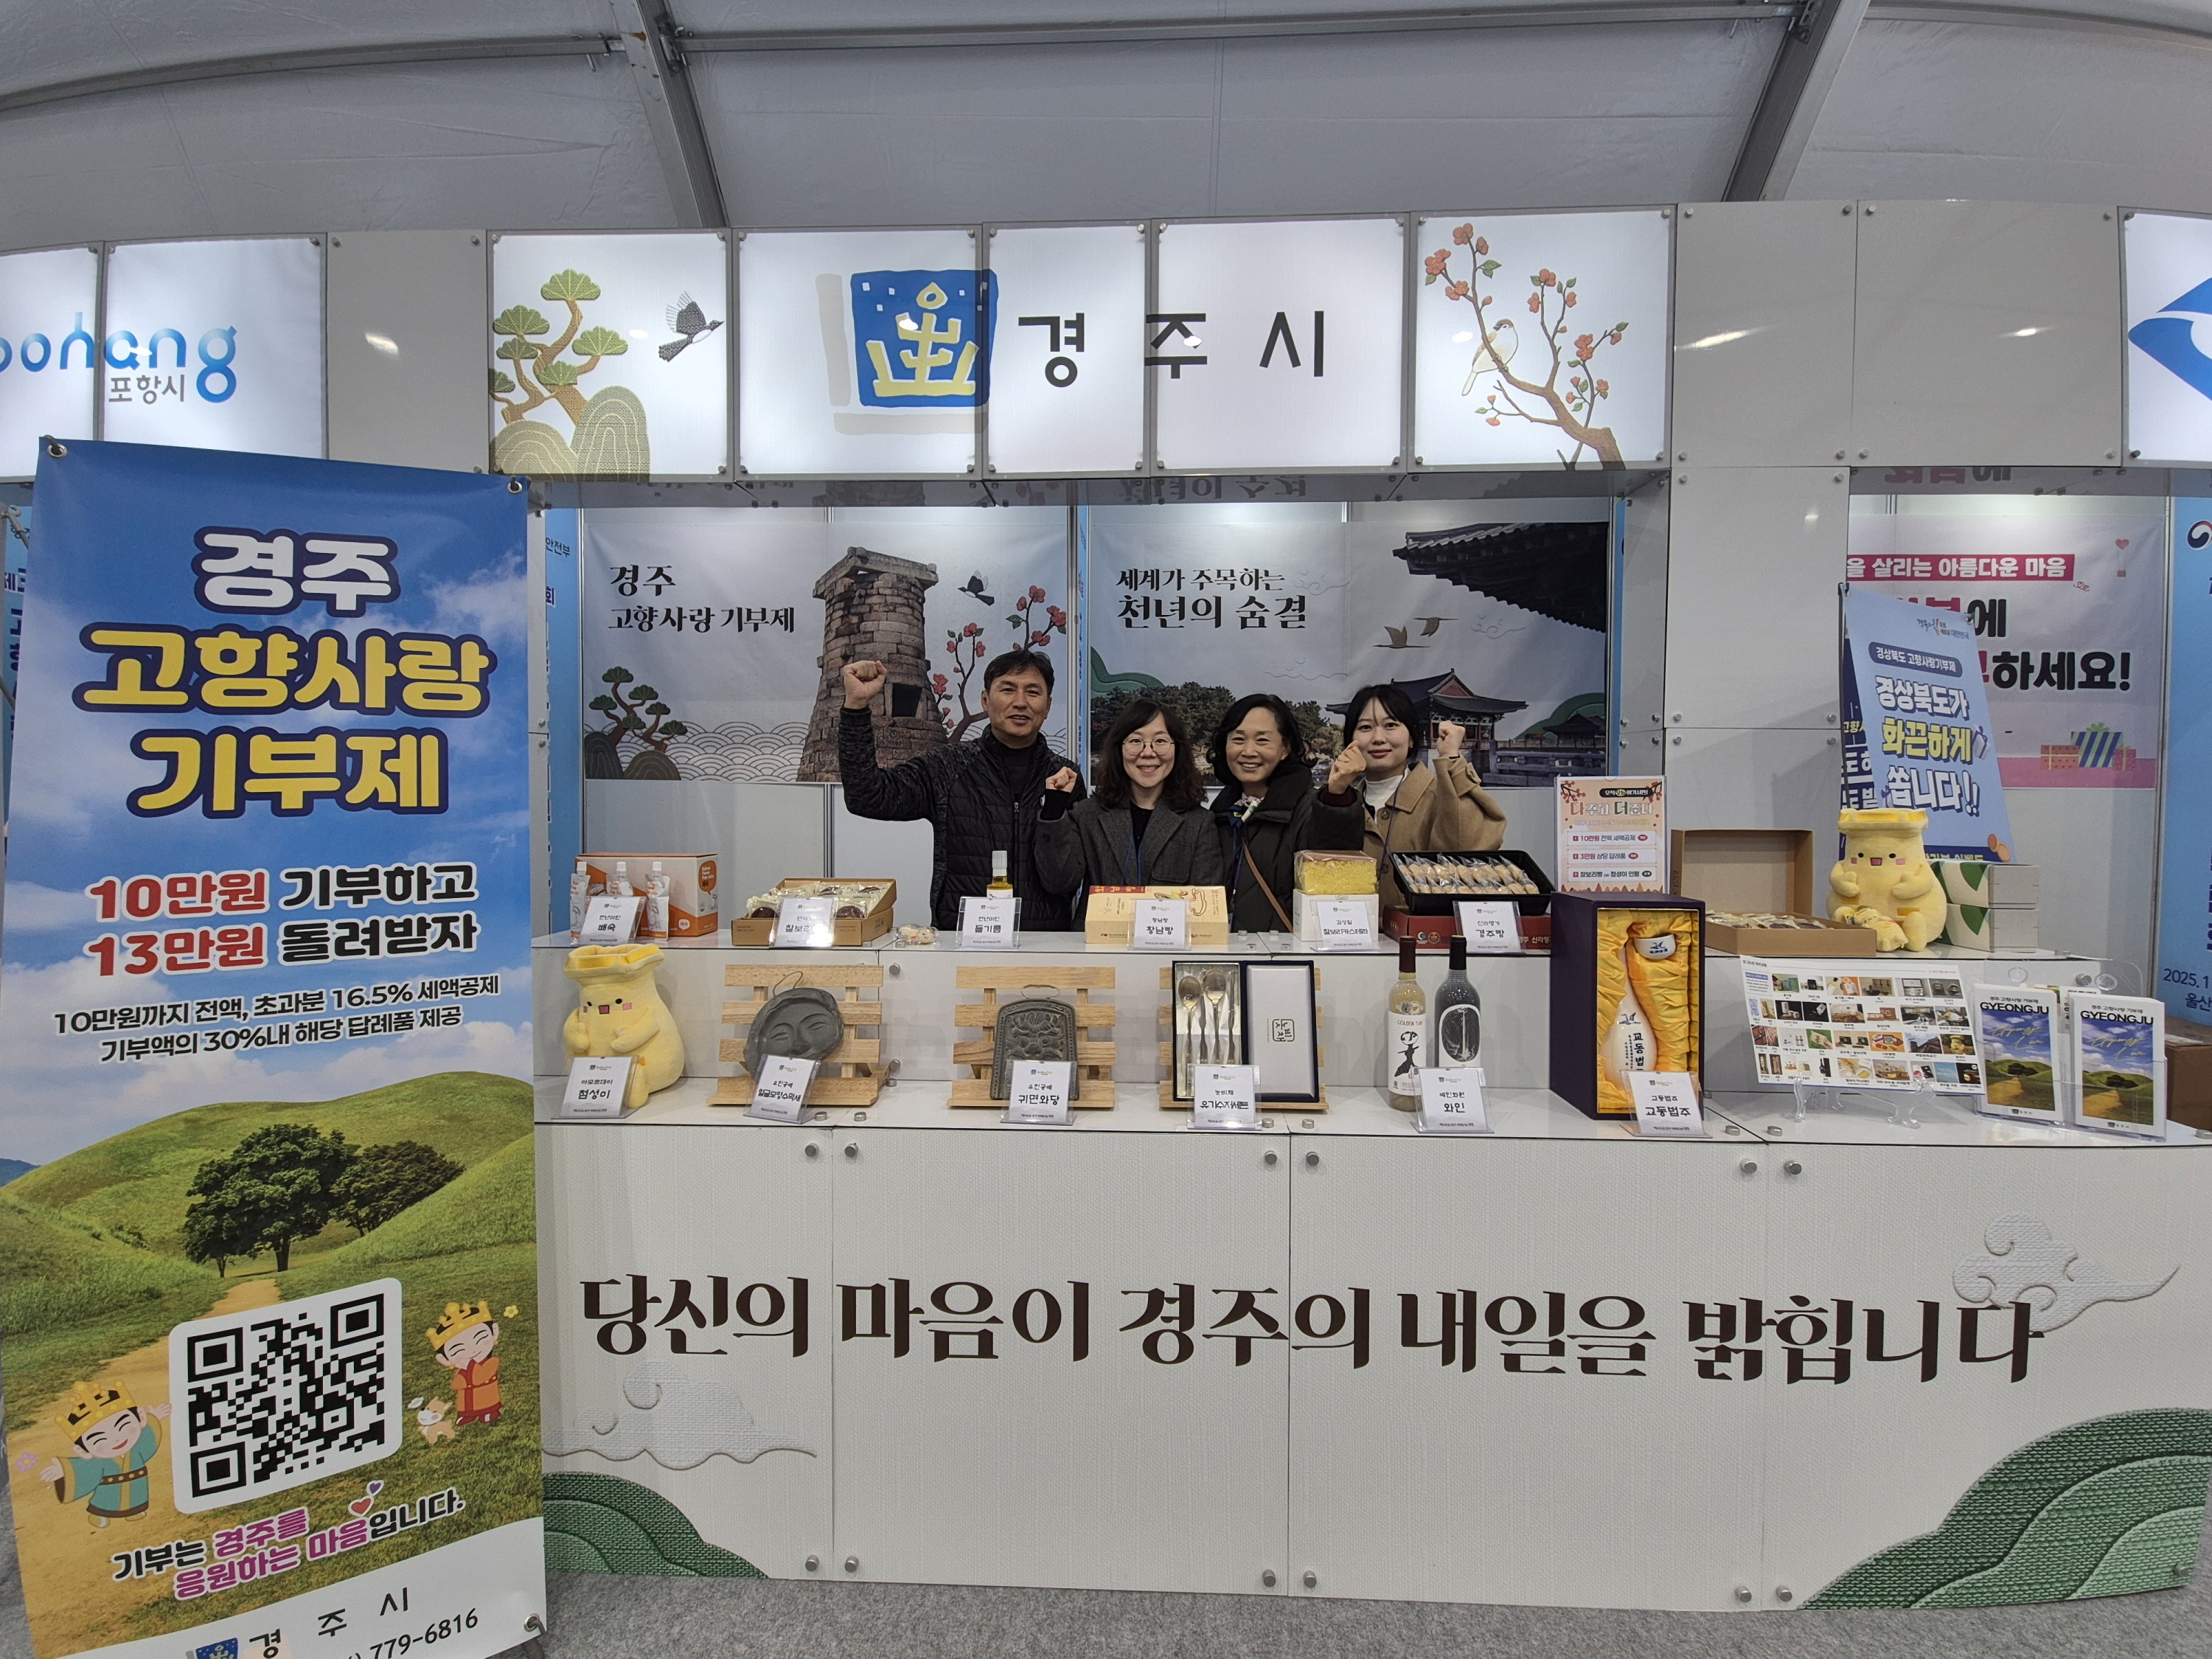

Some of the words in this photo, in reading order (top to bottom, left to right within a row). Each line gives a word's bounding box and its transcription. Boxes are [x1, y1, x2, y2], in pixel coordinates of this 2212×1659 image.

[1018, 310, 1324, 388] 경주시
[108, 375, 185, 405] 포항시
[196, 529, 396, 614] 경주
[610, 564, 675, 597] 경주
[1116, 568, 1185, 591] 세계가
[1191, 568, 1285, 591] 주목하는
[1871, 557, 1932, 577] 살리는
[1938, 557, 2018, 577] 아름다운
[2025, 557, 2066, 577] 마음
[608, 605, 715, 633] 고향사랑
[721, 606, 795, 633] 기부제
[1118, 594, 1222, 630] 천년의
[1235, 594, 1307, 630] 숨결
[80, 627, 493, 714] 고향사랑
[1875, 647, 1907, 663] 경상북도
[1907, 653, 1957, 672] 고향사랑기부제
[1979, 651, 2131, 691] 하세요!
[1875, 675, 1969, 720] 경상북도가
[1882, 717, 1972, 763] 화끈하게
[134, 730, 444, 814] 기부제
[88, 871, 268, 920] 10만원
[282, 864, 477, 911] 기부하고
[87, 925, 265, 977] 13만원
[281, 912, 479, 964] 돌려받자
[975, 925, 1001, 933] 들기름
[1146, 926, 1174, 935] 황남빵
[1475, 930, 1504, 938] 경주빵
[2163, 968, 2212, 989] 2025.1
[55, 1004, 189, 1034] 10만원까지
[195, 997, 249, 1023] 전액,
[254, 990, 325, 1018] 초과분
[333, 982, 413, 1009] 16.5%
[417, 975, 500, 1000] 세액공제
[1980, 1001, 2049, 1015] GYEONGJU
[2081, 1010, 2154, 1025] GYEONGJU
[100, 1033, 198, 1062] 기부액의
[204, 1024, 290, 1052] 30%내
[294, 1018, 343, 1044] 해당
[347, 1012, 414, 1039] 답례품
[419, 1006, 462, 1030] 제공
[1633, 1032, 1644, 1071] 교동법
[578, 1089, 611, 1099] 첨성이
[1018, 1094, 1060, 1105] 귀면와당
[1444, 1102, 1465, 1113] 와인
[580, 1273, 808, 1357] 당신의
[836, 1277, 1090, 1363] 마음이
[1119, 1283, 1371, 1370] 경주의
[1397, 1288, 1657, 1377] 내일을
[1682, 1295, 2045, 1385] 밝힙니다
[113, 1540, 206, 1580] 기부는
[215, 1508, 308, 1558] 경주를
[175, 1545, 299, 1600] 응원하는
[308, 1489, 465, 1559] 마음입니다.
[249, 1587, 410, 1659] 경주시
[369, 1607, 479, 1659] 779-6816
